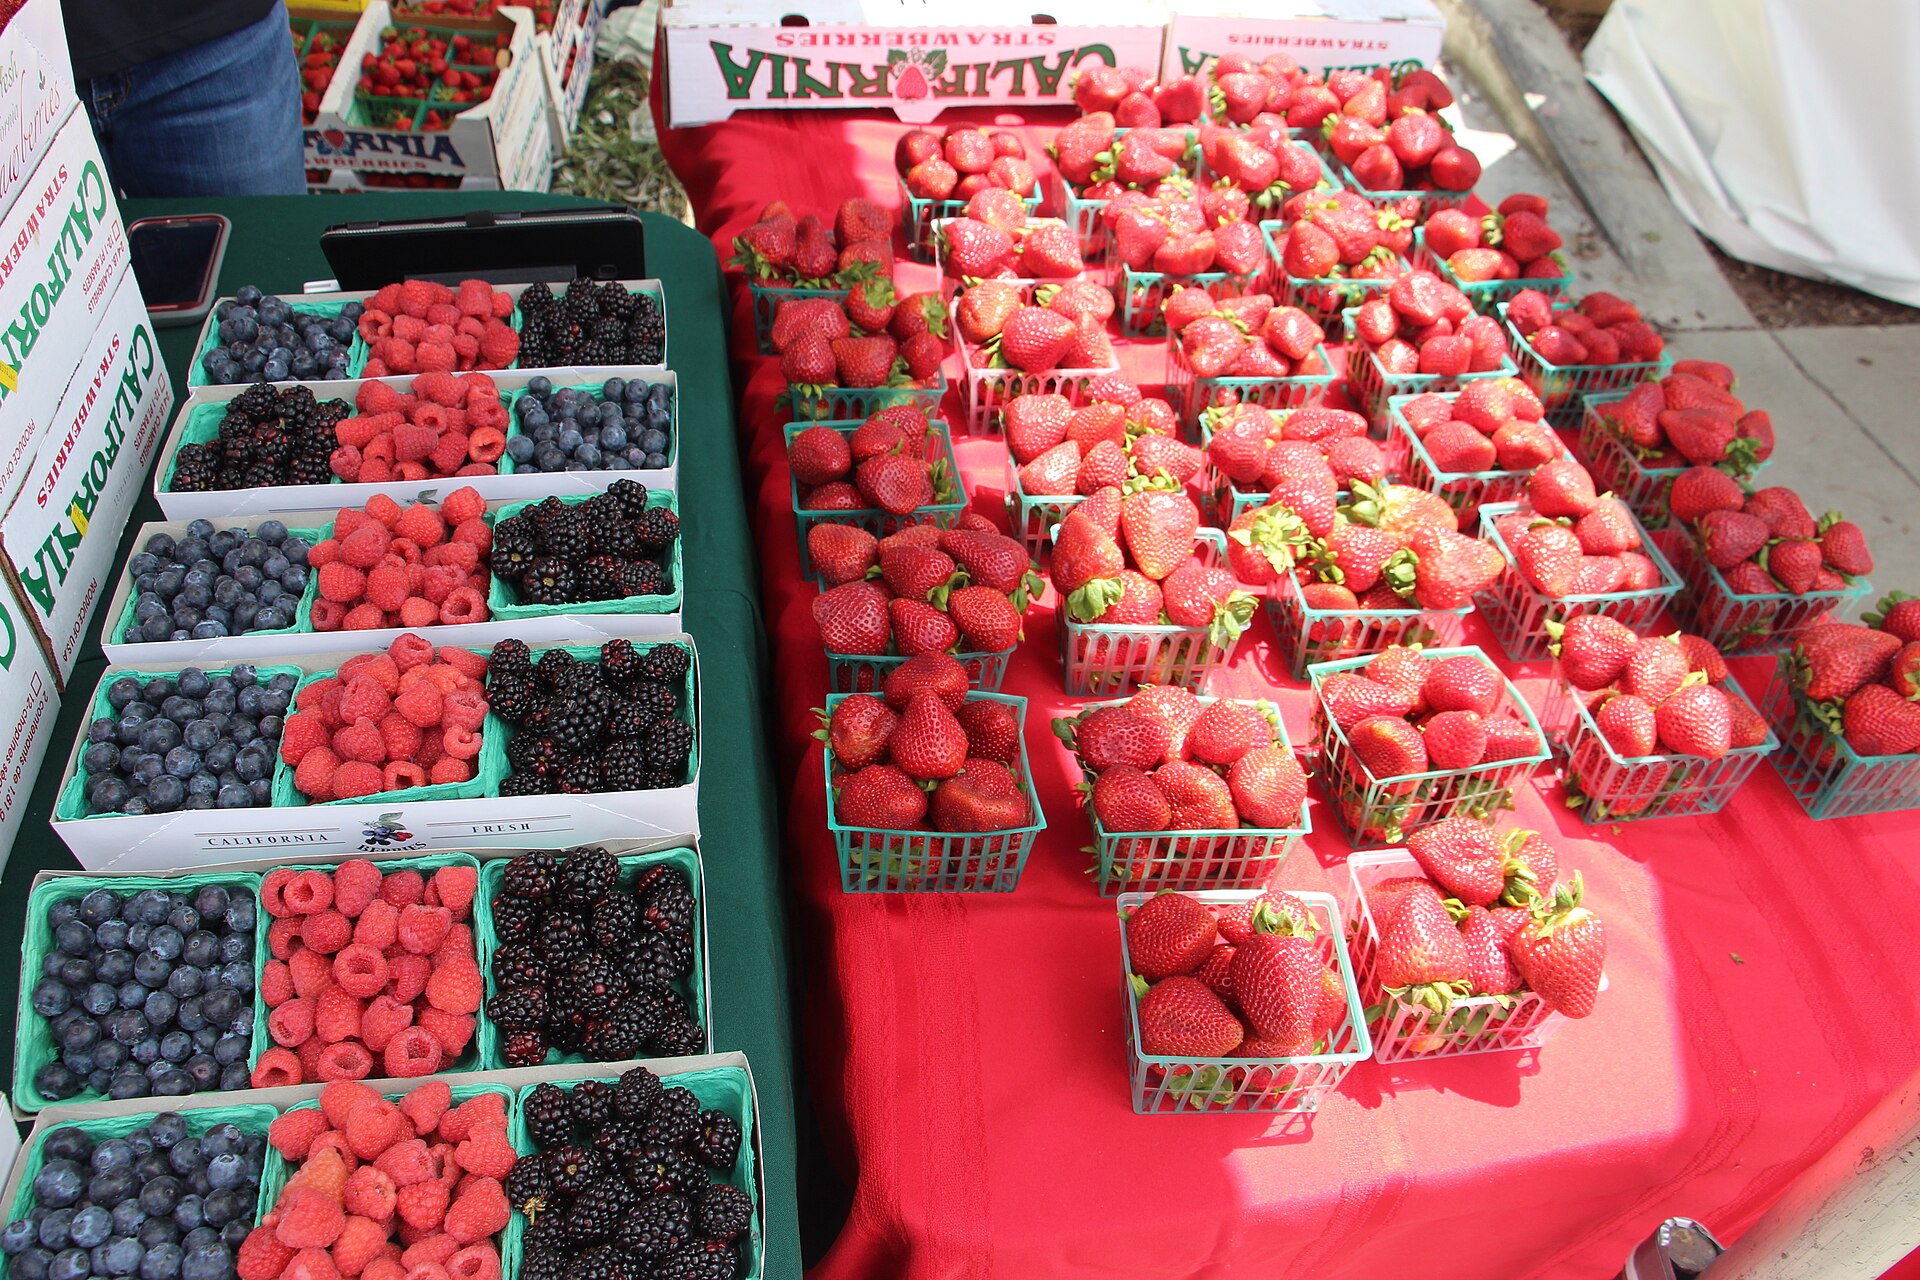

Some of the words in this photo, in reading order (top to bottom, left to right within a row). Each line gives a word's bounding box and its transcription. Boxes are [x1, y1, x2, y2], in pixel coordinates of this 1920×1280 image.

[775, 32, 1057, 47] STRAWBERRIES
[1228, 34, 1389, 51] STRAWBERRIES
[709, 41, 1117, 100] CALIFRNIA
[37, 333, 120, 509] STRAWBERRIES
[12, 418, 36, 466] PRODUCE
[78, 577, 97, 625] PRODUCE
[73, 621, 81, 639] OF
[20, 700, 44, 765] contenants
[13, 766, 21, 784] de
[207, 833, 329, 846] CALIFORNIA
[472, 823, 530, 833] FRESH
